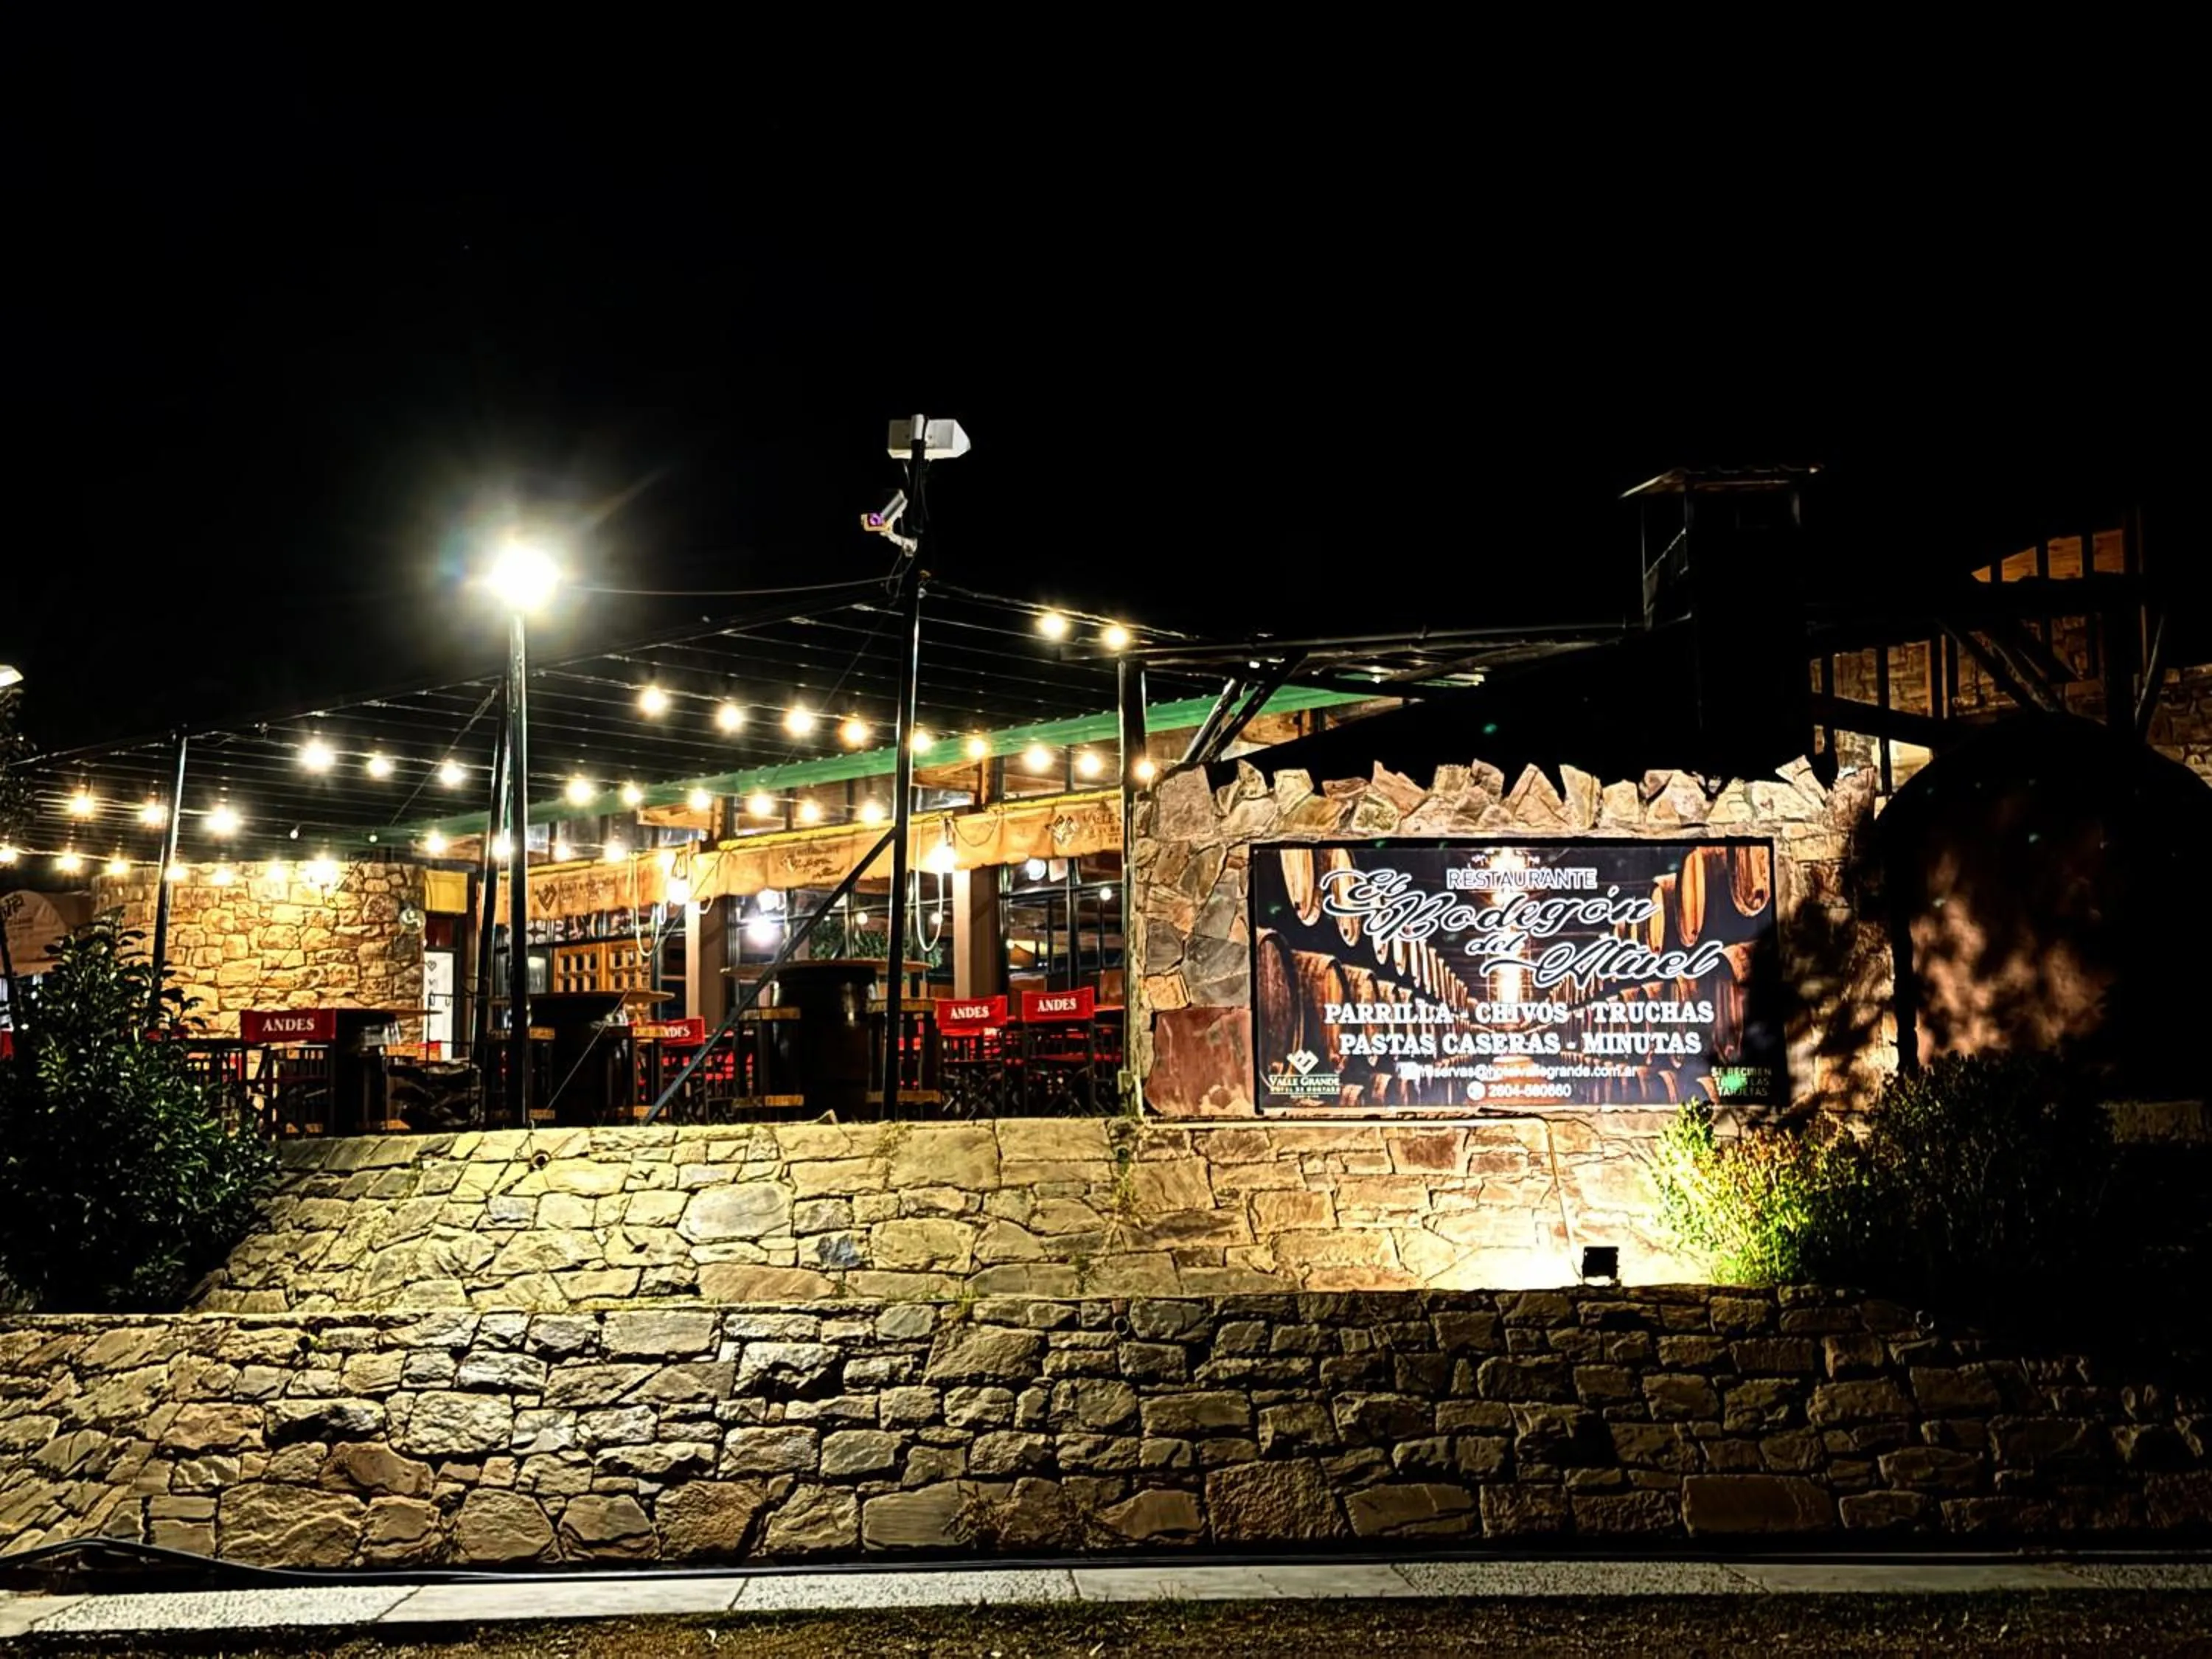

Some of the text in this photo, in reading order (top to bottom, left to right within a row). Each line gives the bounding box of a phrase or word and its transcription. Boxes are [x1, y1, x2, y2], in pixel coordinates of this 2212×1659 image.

[1446, 868, 1598, 889] RESTAURANTE
[1320, 868, 1413, 917] El
[1363, 886, 1660, 942] Bodegón
[1464, 931, 1529, 956] del
[950, 1005, 990, 1020] ANDES
[1037, 998, 1077, 1012] ANDES
[1324, 1002, 1454, 1024] PARRILLA
[1475, 1001, 1569, 1024] CHIVOS
[1590, 1000, 1714, 1023] TRUCHAS
[262, 1018, 315, 1032] ANDES
[1339, 1033, 1437, 1055] PASTAS
[1442, 1032, 1561, 1055] CASERAS
[1583, 1032, 1703, 1054] MINUTAS
[1269, 1075, 1340, 1085] VALLE GRANDE
